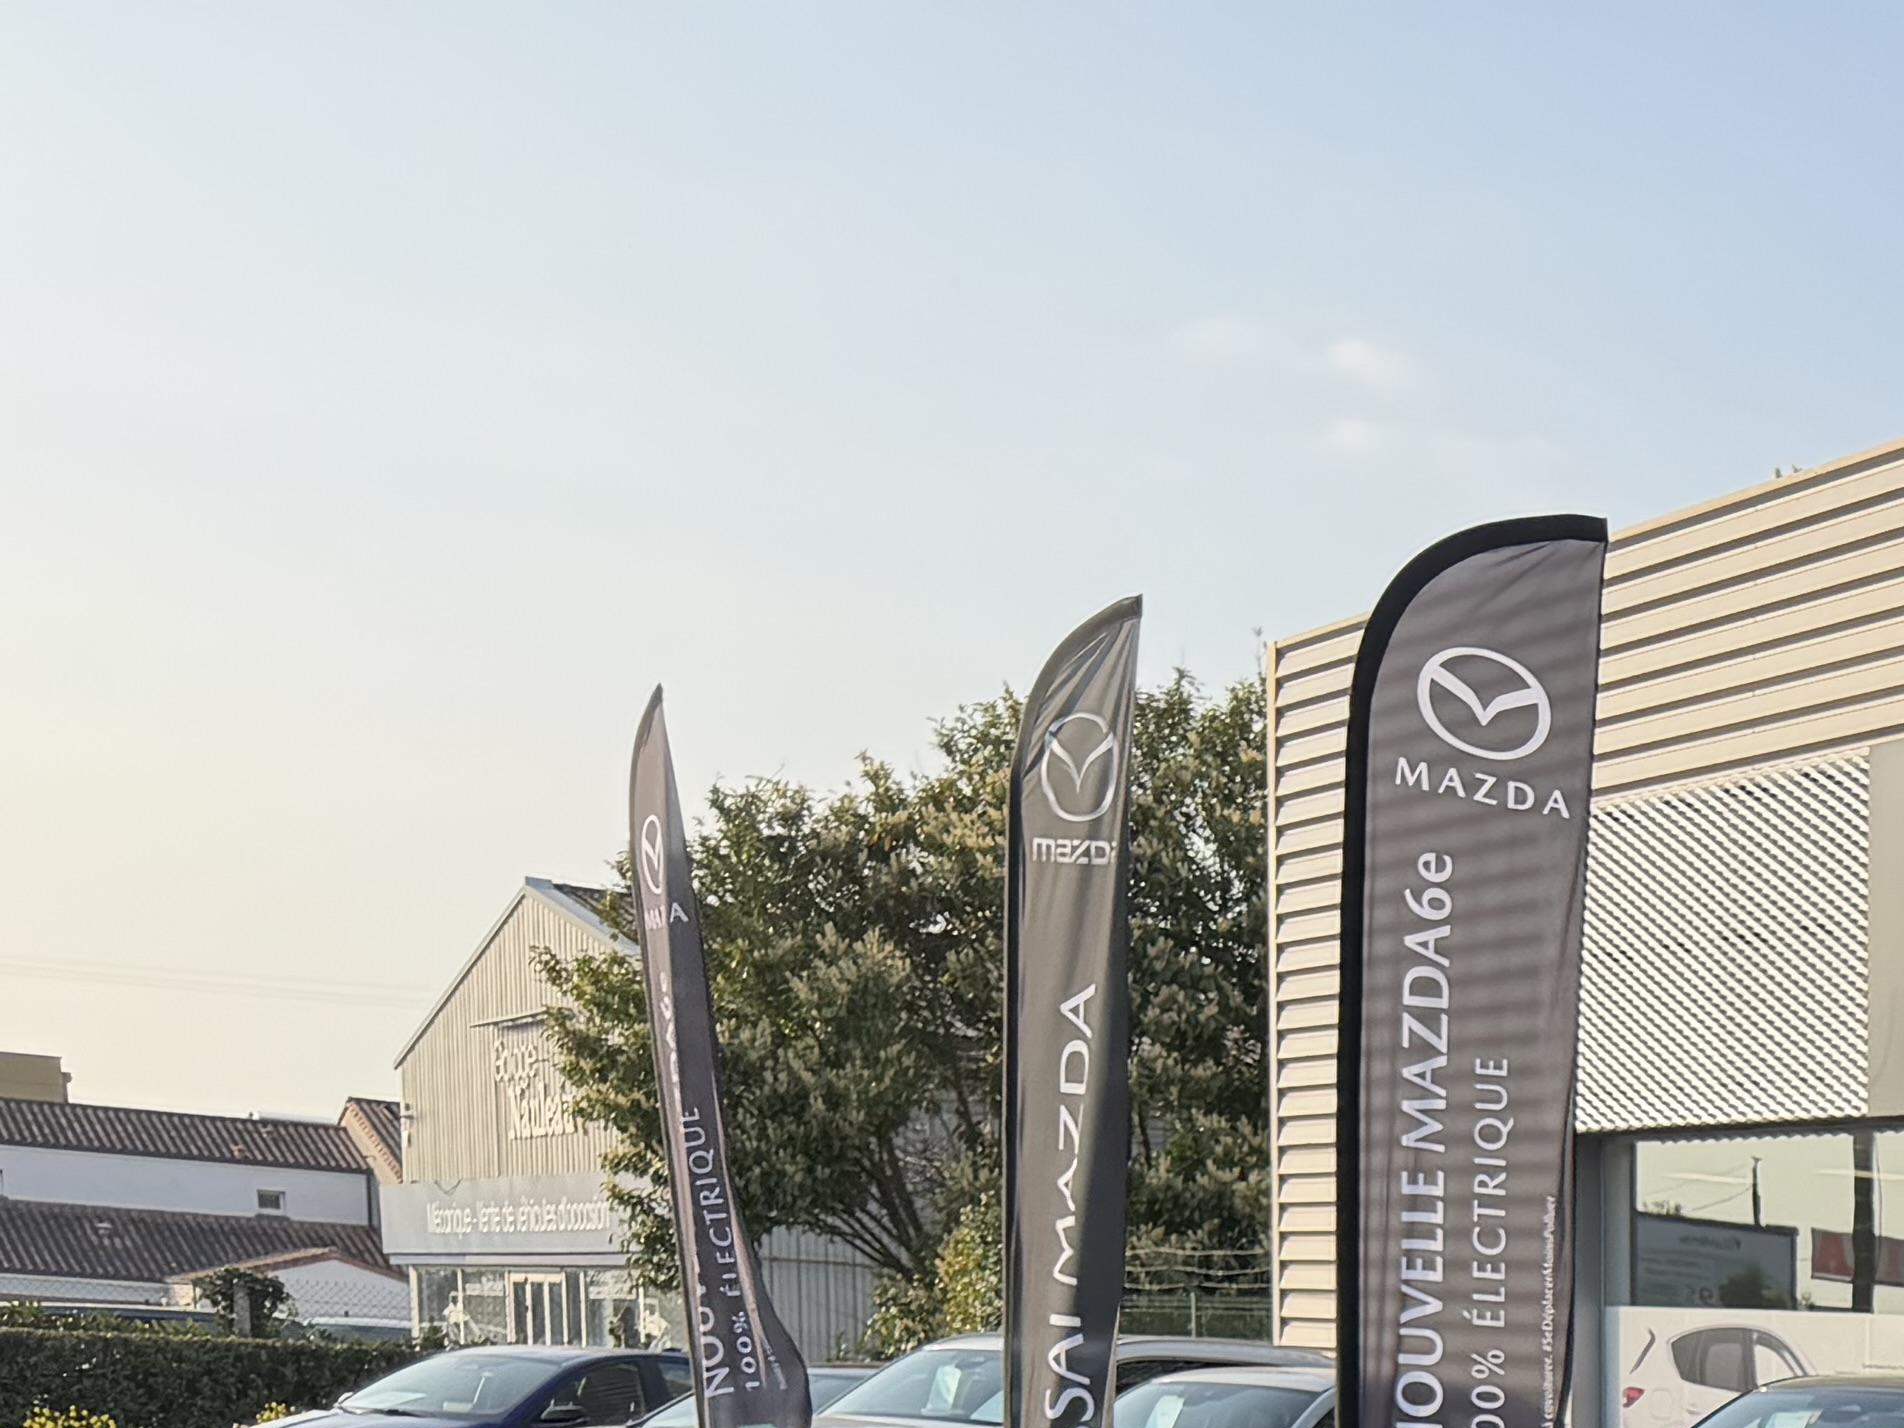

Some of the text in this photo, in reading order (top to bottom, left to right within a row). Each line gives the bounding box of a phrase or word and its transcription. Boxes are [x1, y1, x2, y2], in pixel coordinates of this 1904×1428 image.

[1395, 757, 1570, 819] MAZDA
[1052, 983, 1097, 1287] MAZDA
[1401, 852, 1453, 1152] MAZDA6e
[1463, 1058, 1514, 1328] ÉLECTRIQUE
